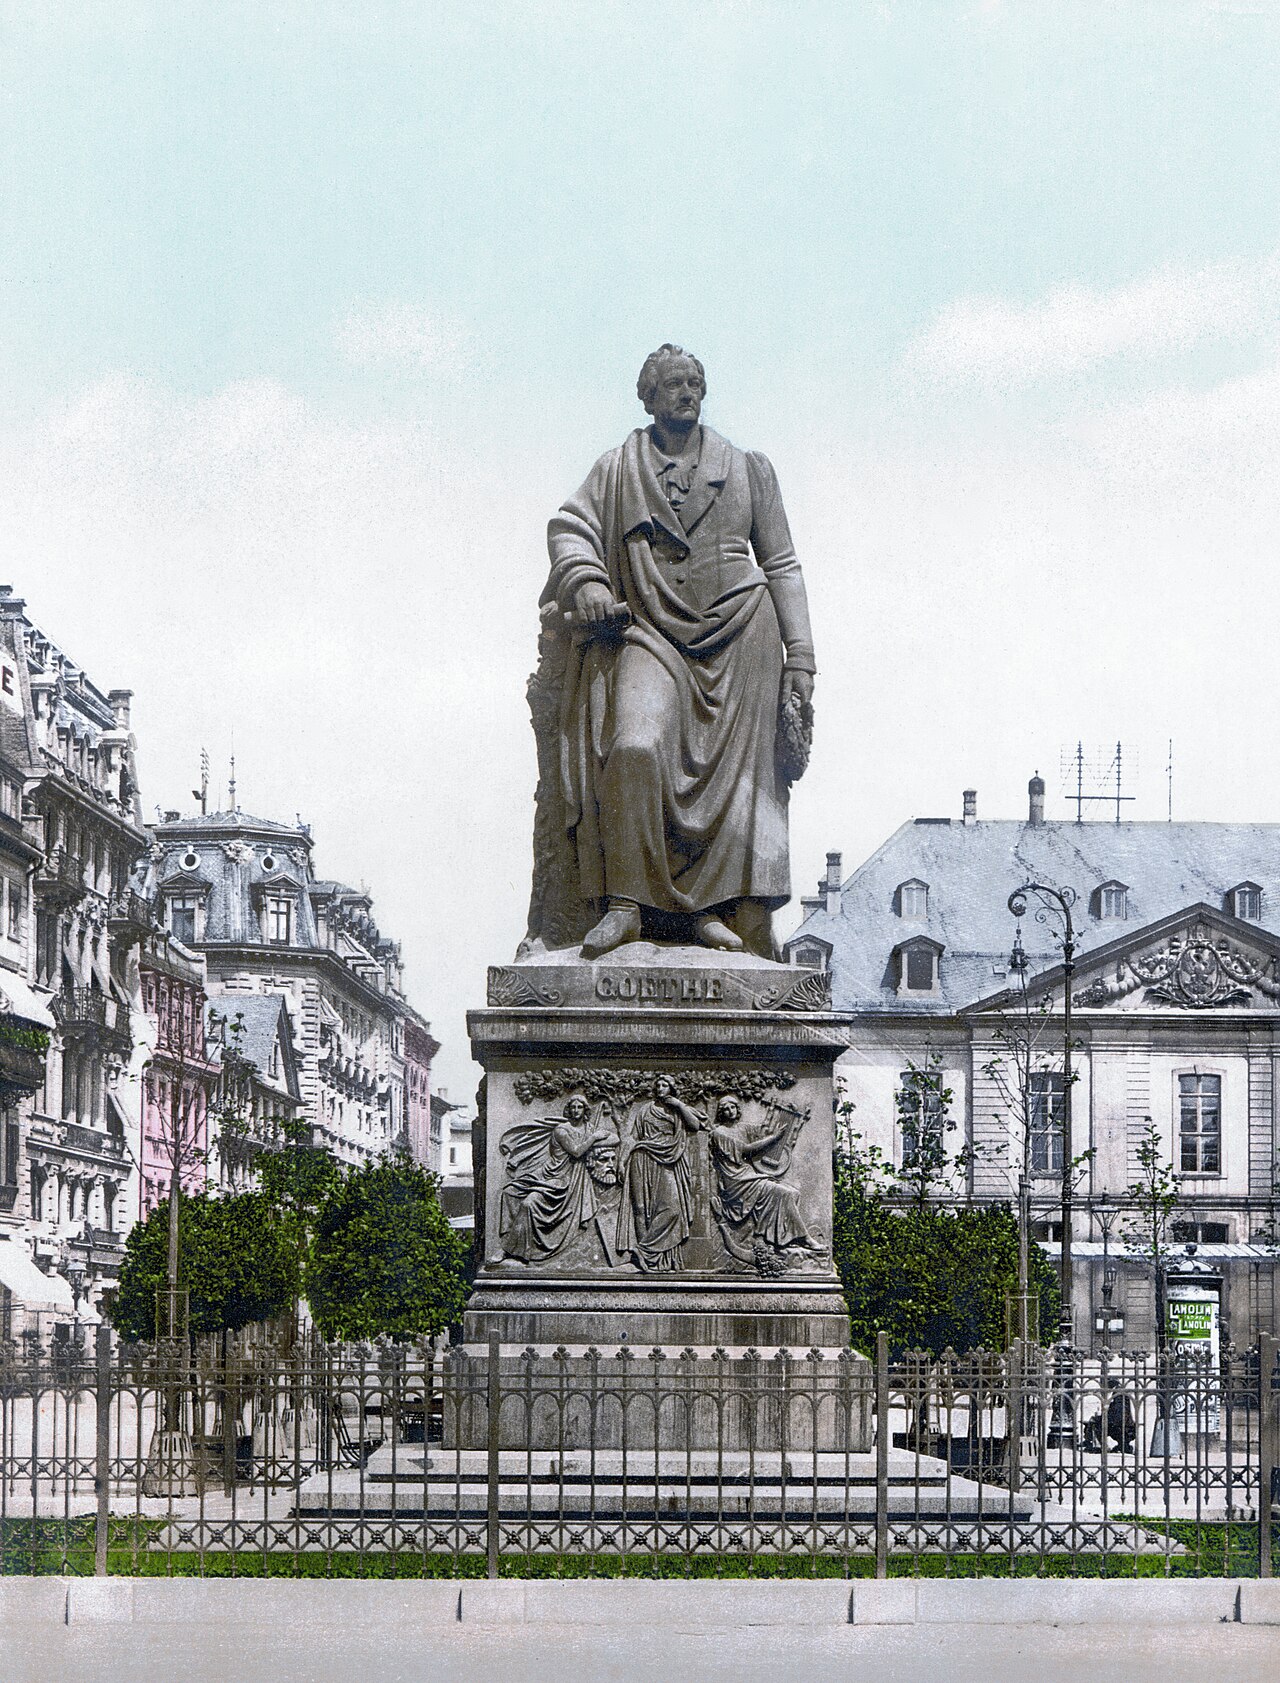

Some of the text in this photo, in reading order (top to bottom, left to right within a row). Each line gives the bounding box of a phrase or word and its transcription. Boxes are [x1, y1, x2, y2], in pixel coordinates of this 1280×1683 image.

[2, 665, 14, 696] E
[595, 977, 723, 1001] GOETHE
[1169, 1303, 1211, 1319] LANOLIN
